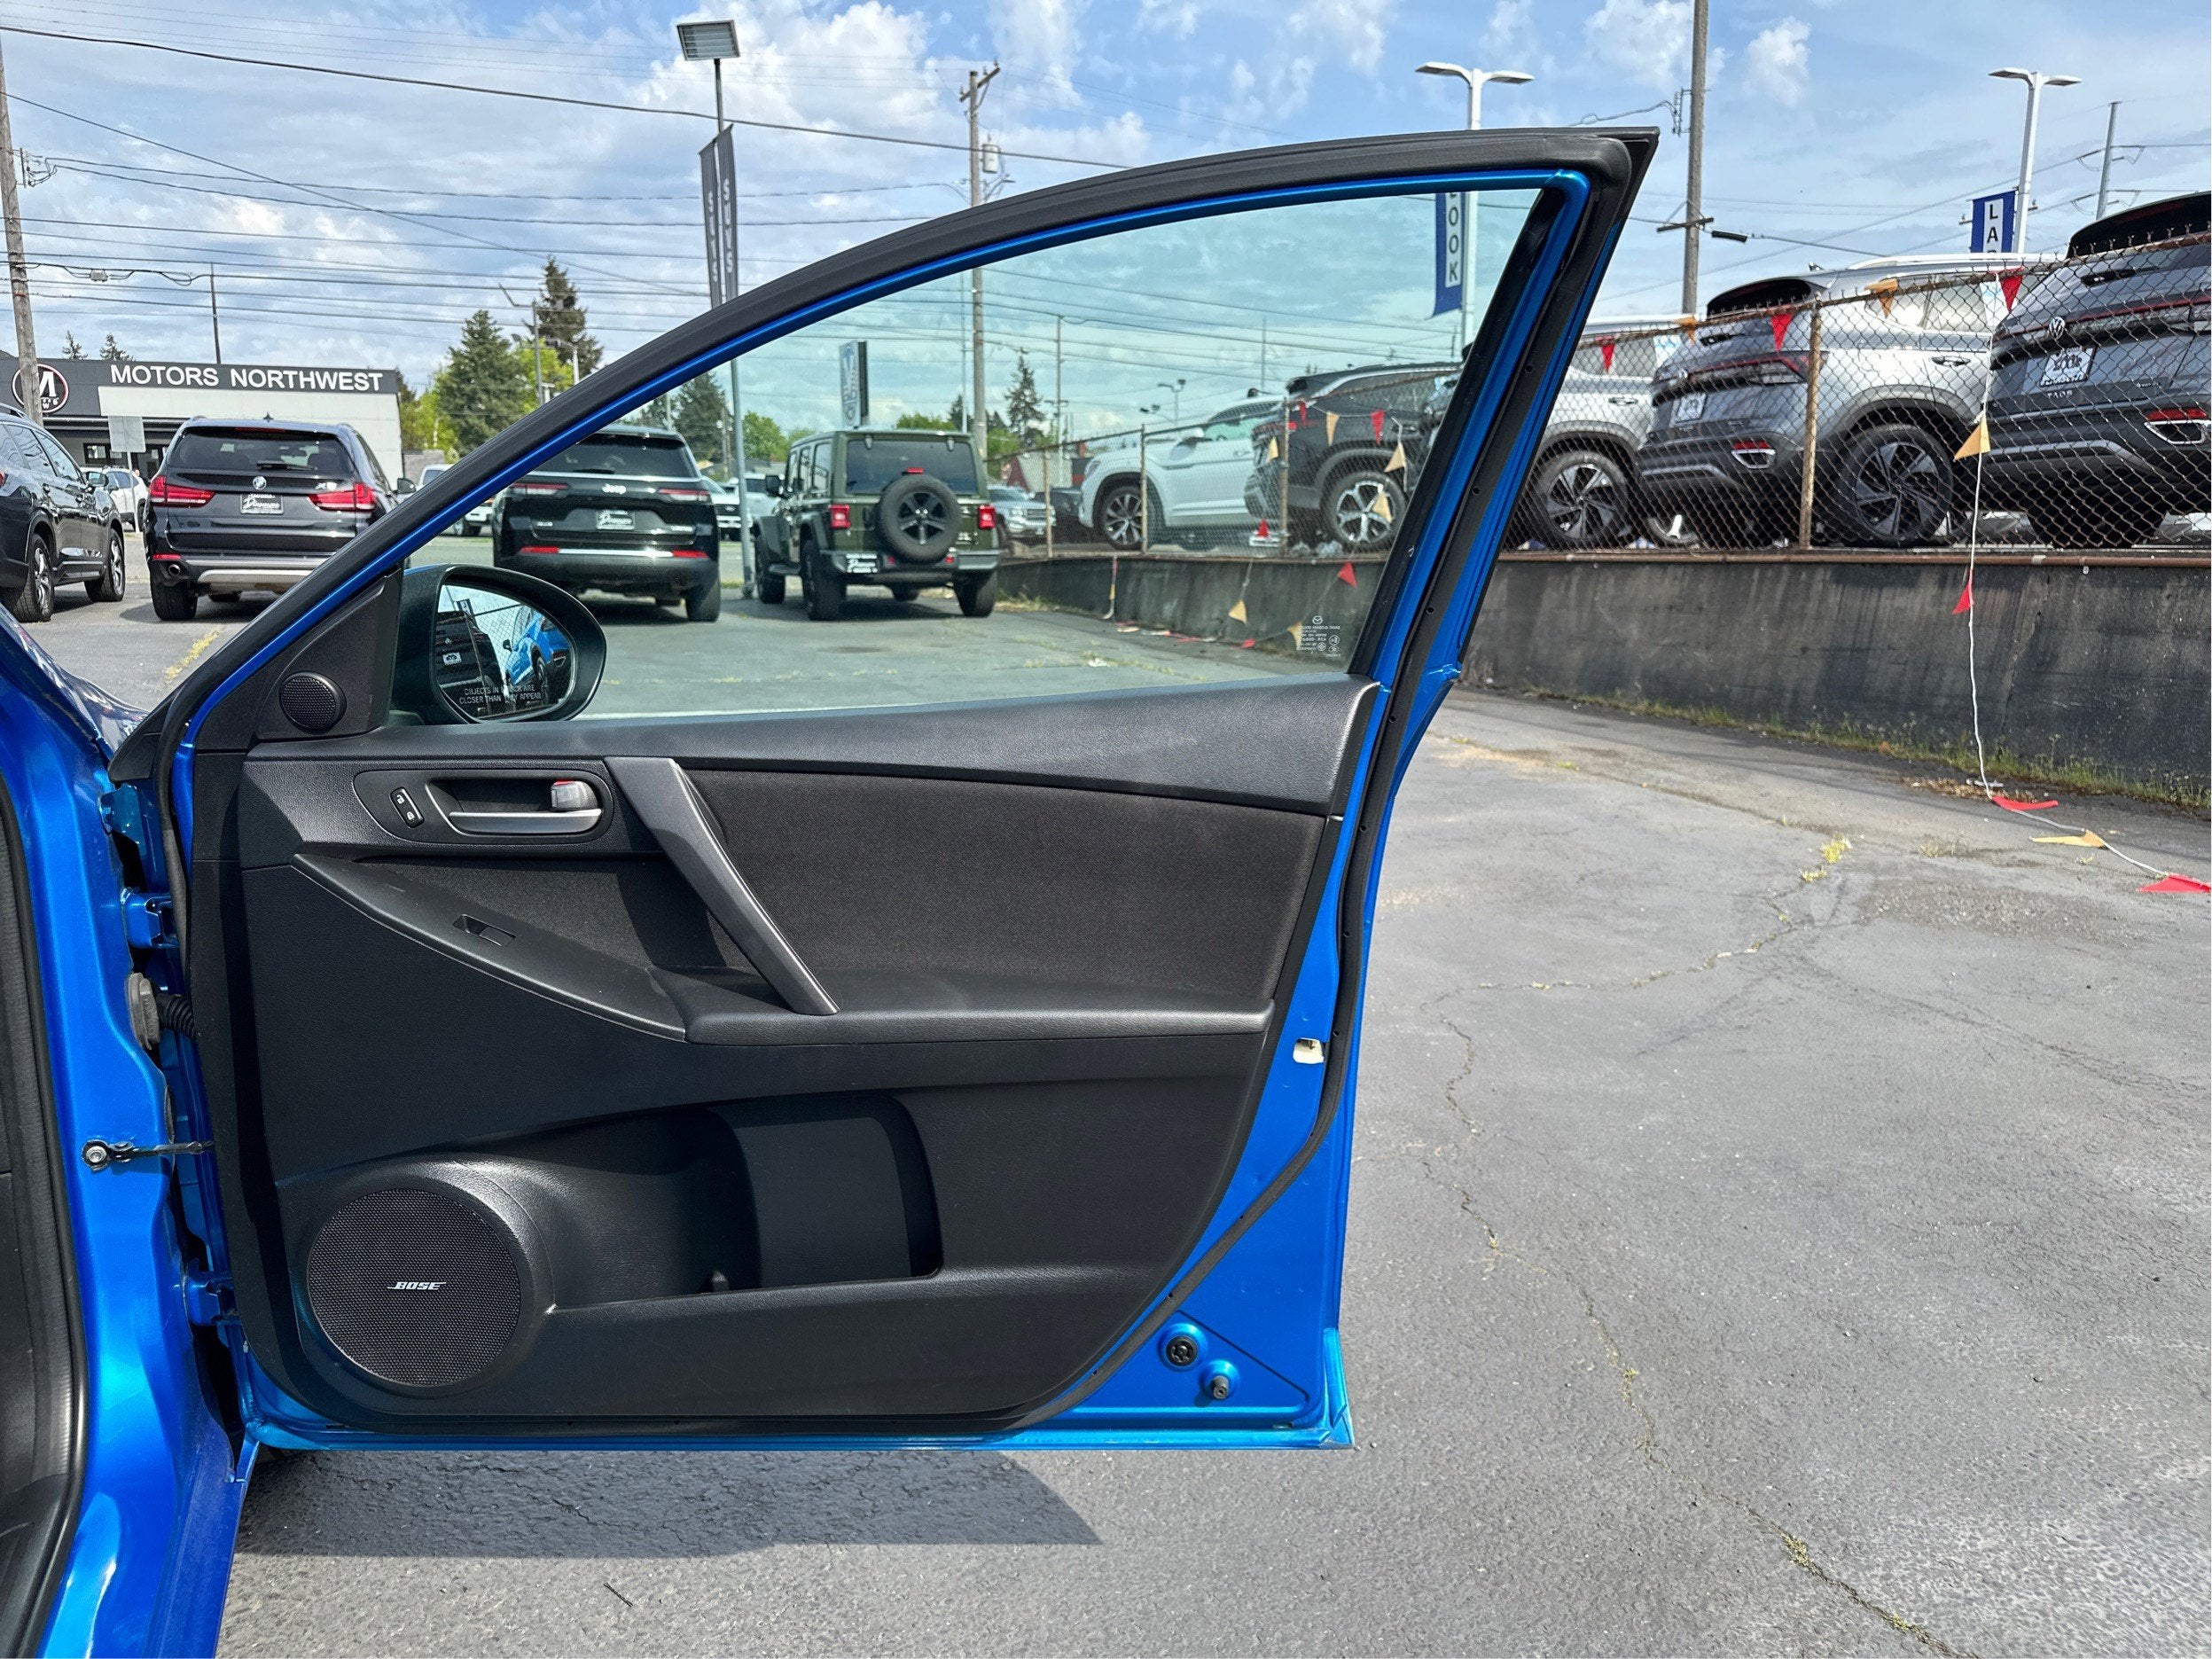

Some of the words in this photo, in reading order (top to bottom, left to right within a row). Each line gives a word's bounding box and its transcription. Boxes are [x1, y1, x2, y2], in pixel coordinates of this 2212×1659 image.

[1987, 204, 1998, 253] LA
[110, 364, 219, 387] MOTORS
[230, 368, 383, 392] NORTHWEST
[458, 696, 484, 705] CLOSER
[387, 1281, 446, 1290] BOSE
